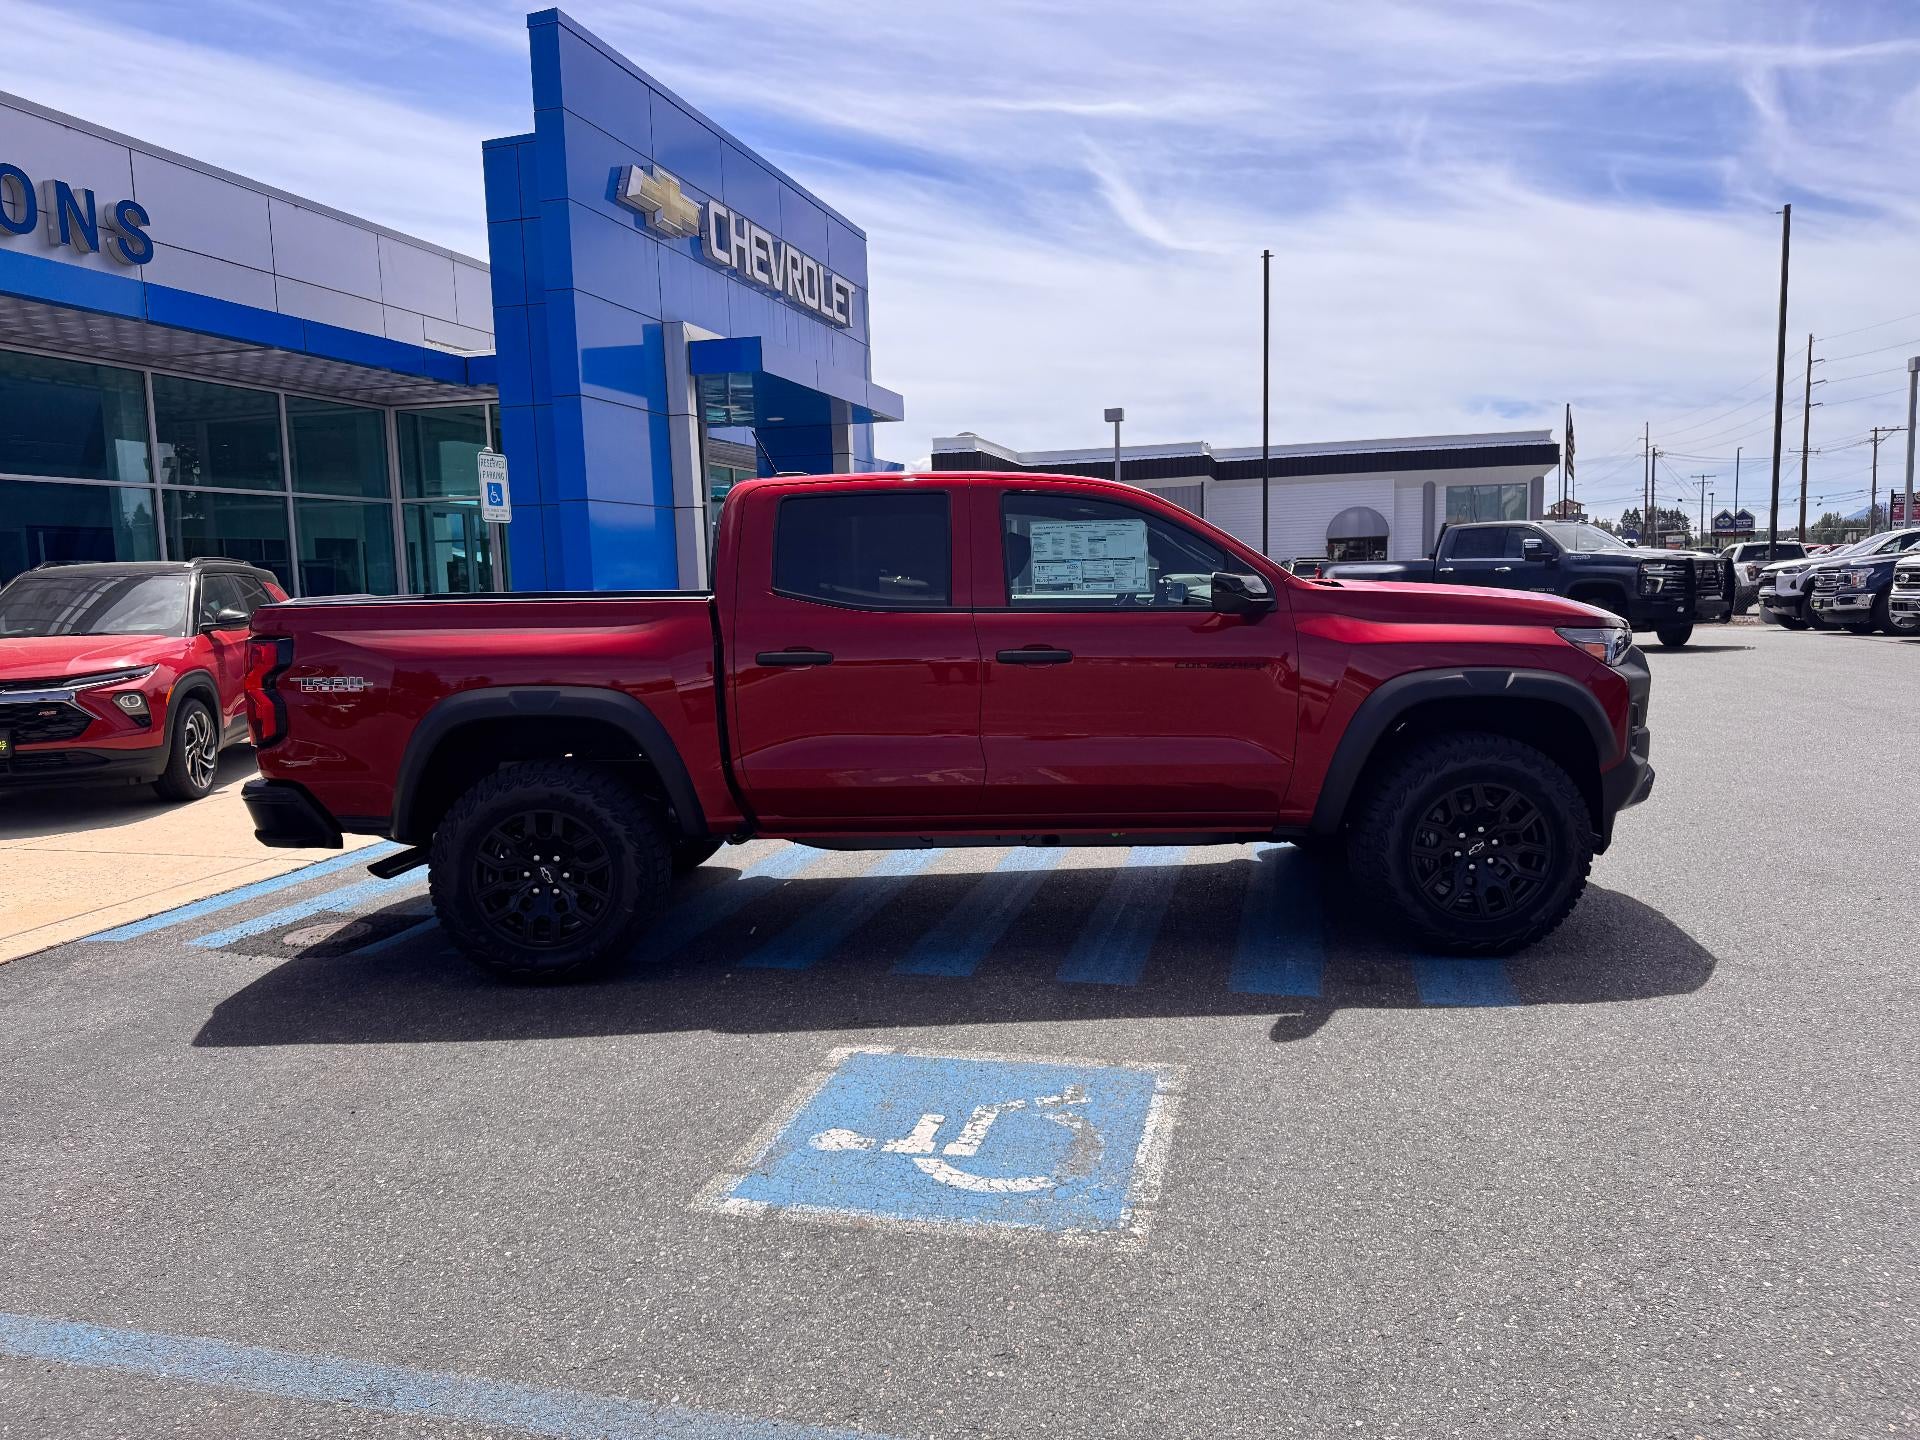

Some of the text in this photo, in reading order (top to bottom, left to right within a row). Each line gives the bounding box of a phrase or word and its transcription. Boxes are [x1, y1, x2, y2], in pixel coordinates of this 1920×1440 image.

[707, 199, 856, 329] CHEVROLET
[480, 457, 505, 469] RESERVED
[482, 470, 505, 481] PARKING
